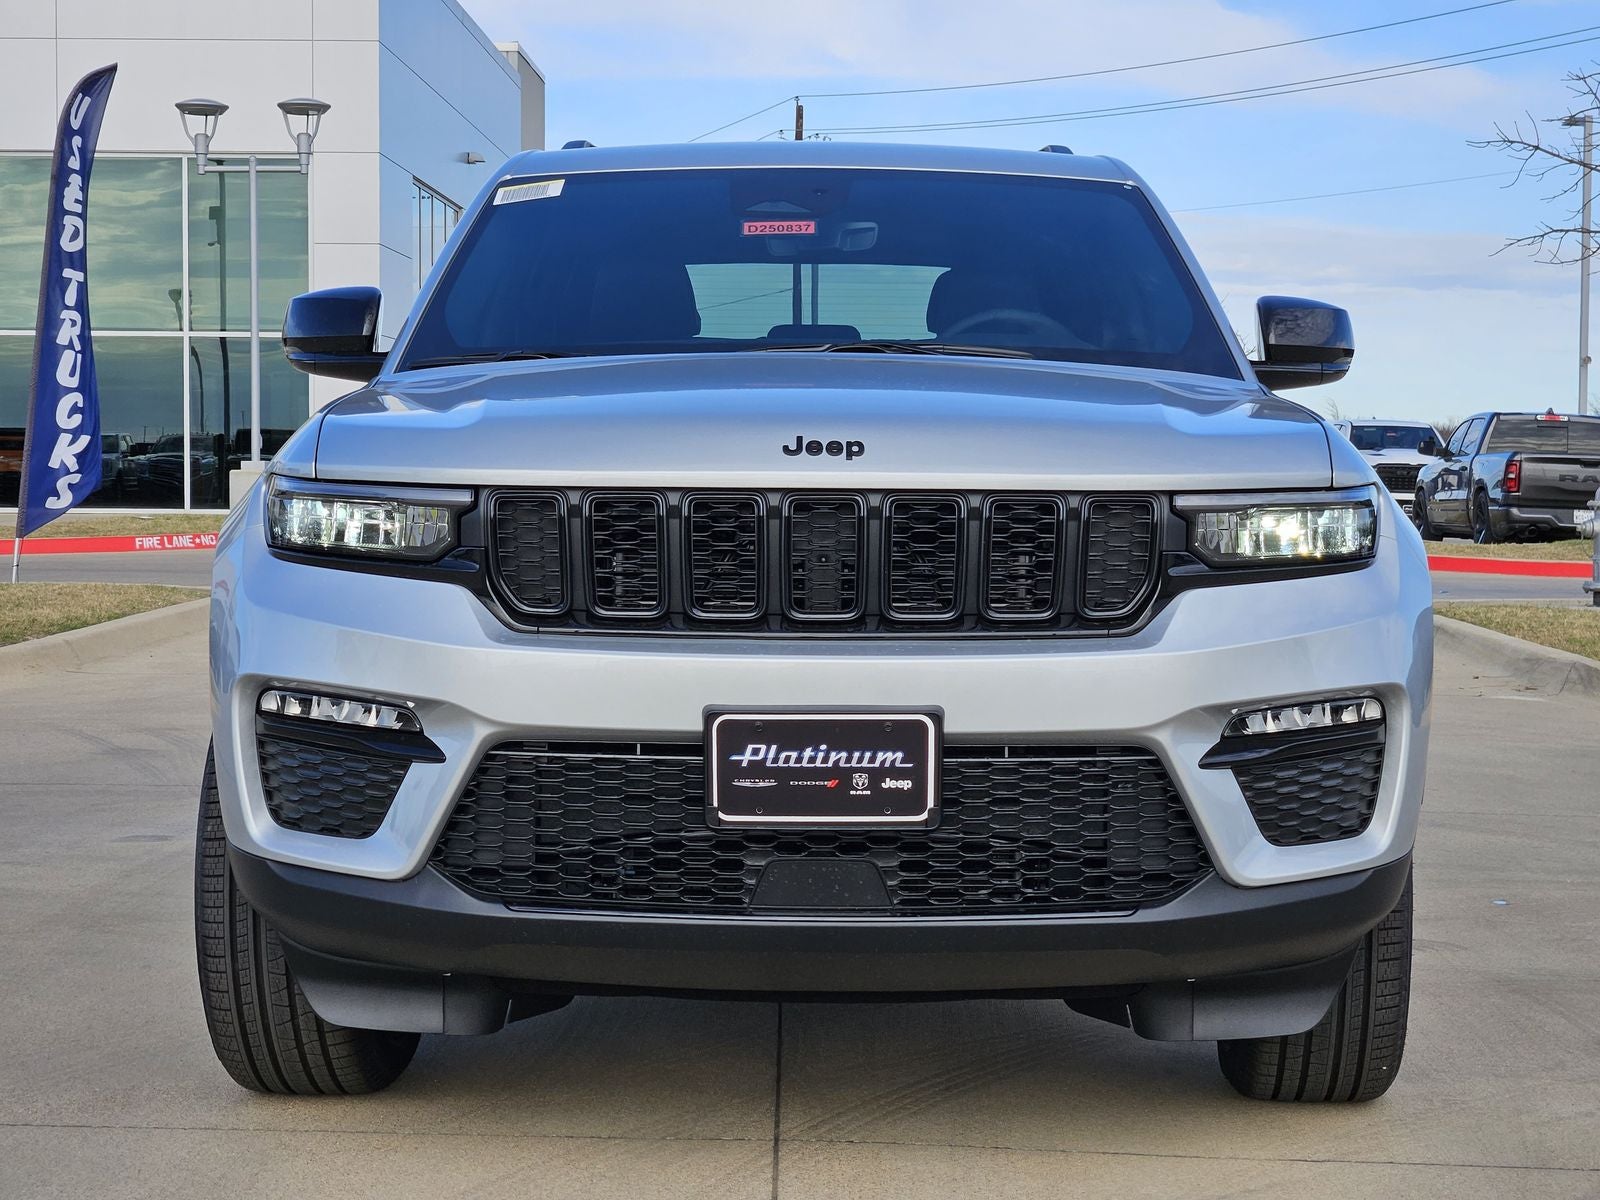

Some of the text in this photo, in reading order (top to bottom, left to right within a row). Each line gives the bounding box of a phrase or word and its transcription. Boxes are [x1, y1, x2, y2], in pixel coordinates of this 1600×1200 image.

[747, 223, 811, 233] D250837
[45, 92, 91, 509] USED TRUCKS
[782, 435, 865, 461] Jeep
[135, 536, 162, 549] FIRE
[729, 744, 914, 768] Platinum
[881, 778, 912, 790] Jeep
